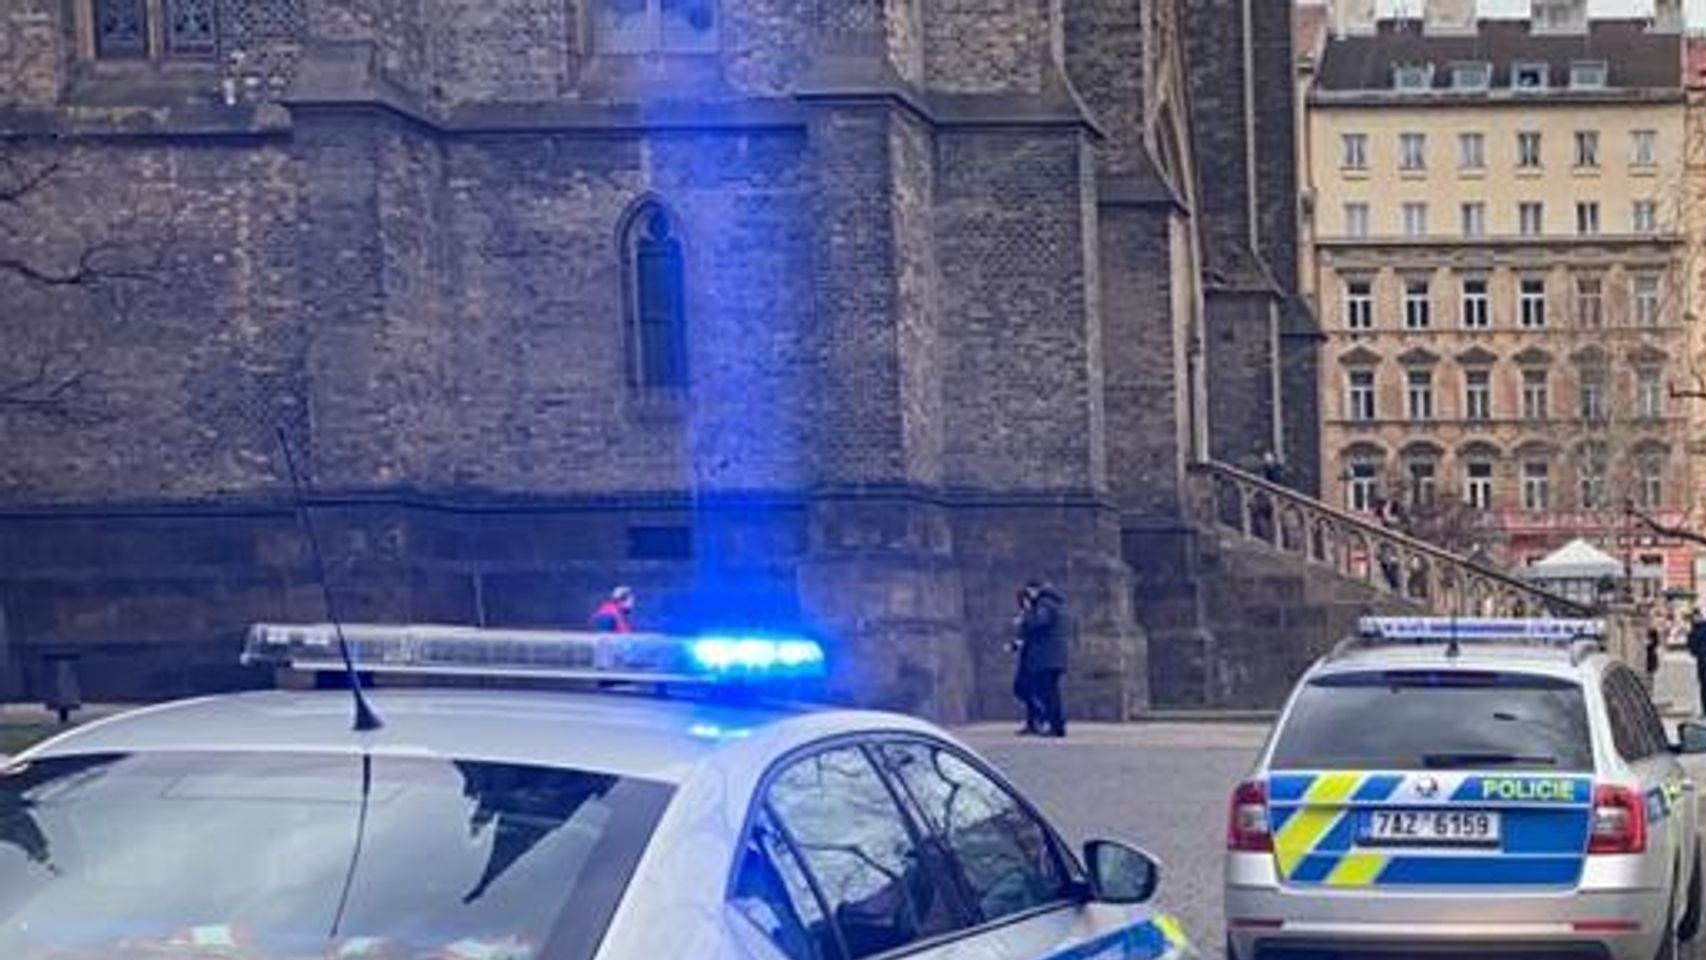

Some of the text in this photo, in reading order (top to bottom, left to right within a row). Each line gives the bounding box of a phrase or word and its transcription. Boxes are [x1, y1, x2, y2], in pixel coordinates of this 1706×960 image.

[1483, 779, 1575, 801] POLICIE
[1377, 813, 1489, 836] 7AZ 6159
